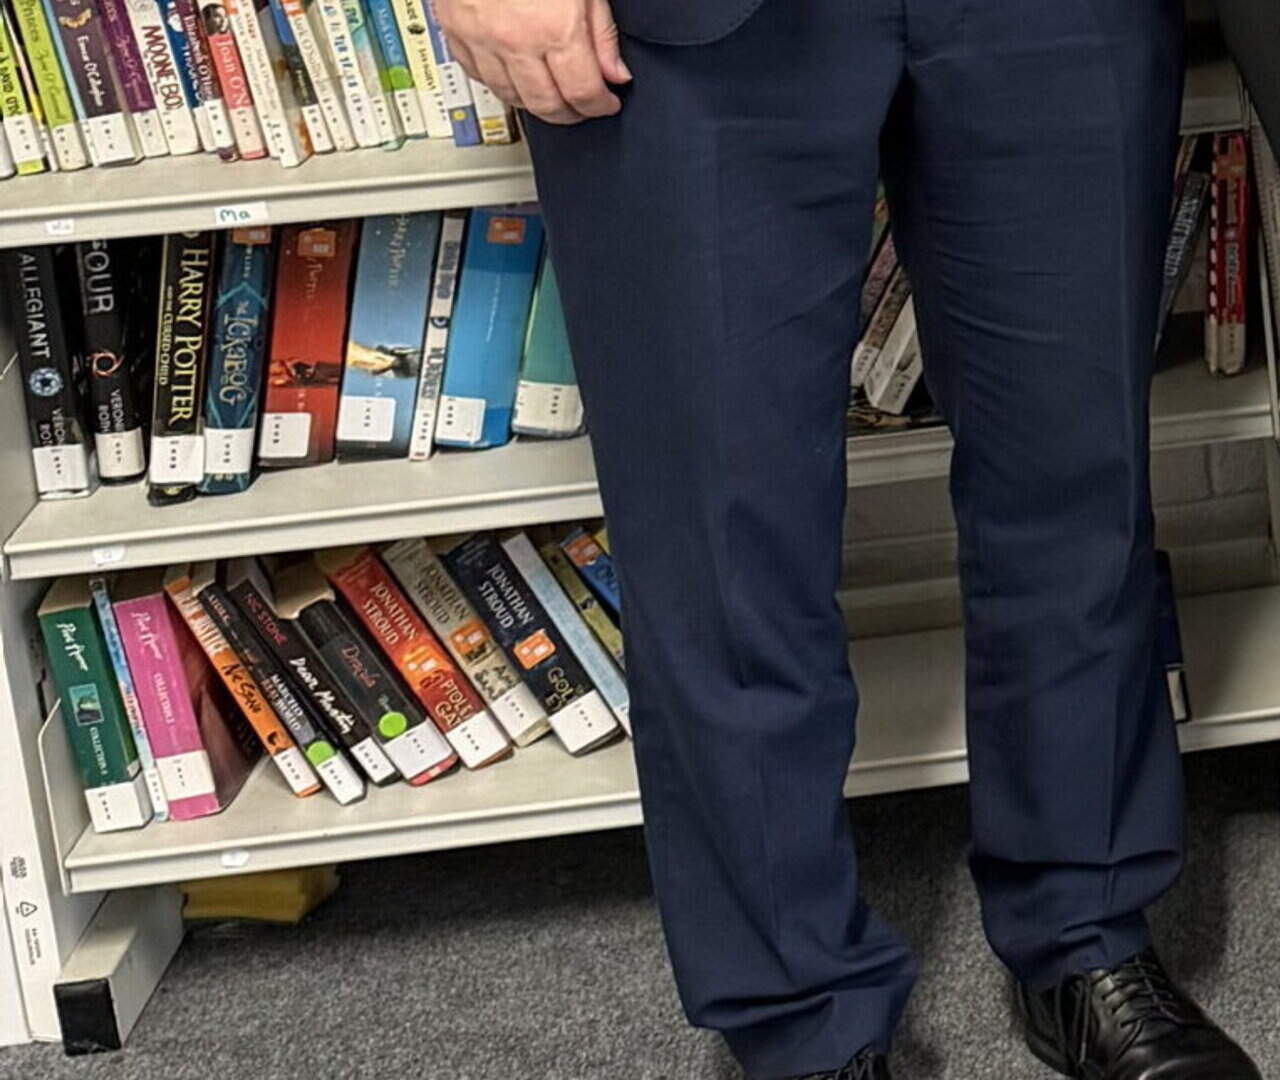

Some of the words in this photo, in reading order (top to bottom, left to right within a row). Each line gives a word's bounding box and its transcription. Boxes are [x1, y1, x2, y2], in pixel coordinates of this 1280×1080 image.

[141, 21, 176, 84] MOONE
[216, 36, 241, 74] Joan
[219, 208, 250, 222] Ma
[18, 252, 49, 359] ALLEGIANT
[172, 247, 212, 328] HARRY
[163, 335, 205, 425] POTTER
[38, 423, 50, 447] ROT
[109, 388, 123, 431] VERONI
[369, 579, 421, 644] JONATHAN
[412, 575, 454, 627] STROUD
[421, 559, 472, 624] JONATHAN
[476, 579, 516, 630] STROUD
[485, 561, 536, 627] JONATHAN
[256, 608, 290, 650] STONE
[359, 595, 403, 648] STROUD
[338, 640, 381, 691] Dracula
[491, 661, 518, 692] AM
[288, 653, 322, 692] Dear
[312, 682, 358, 737] Martin
